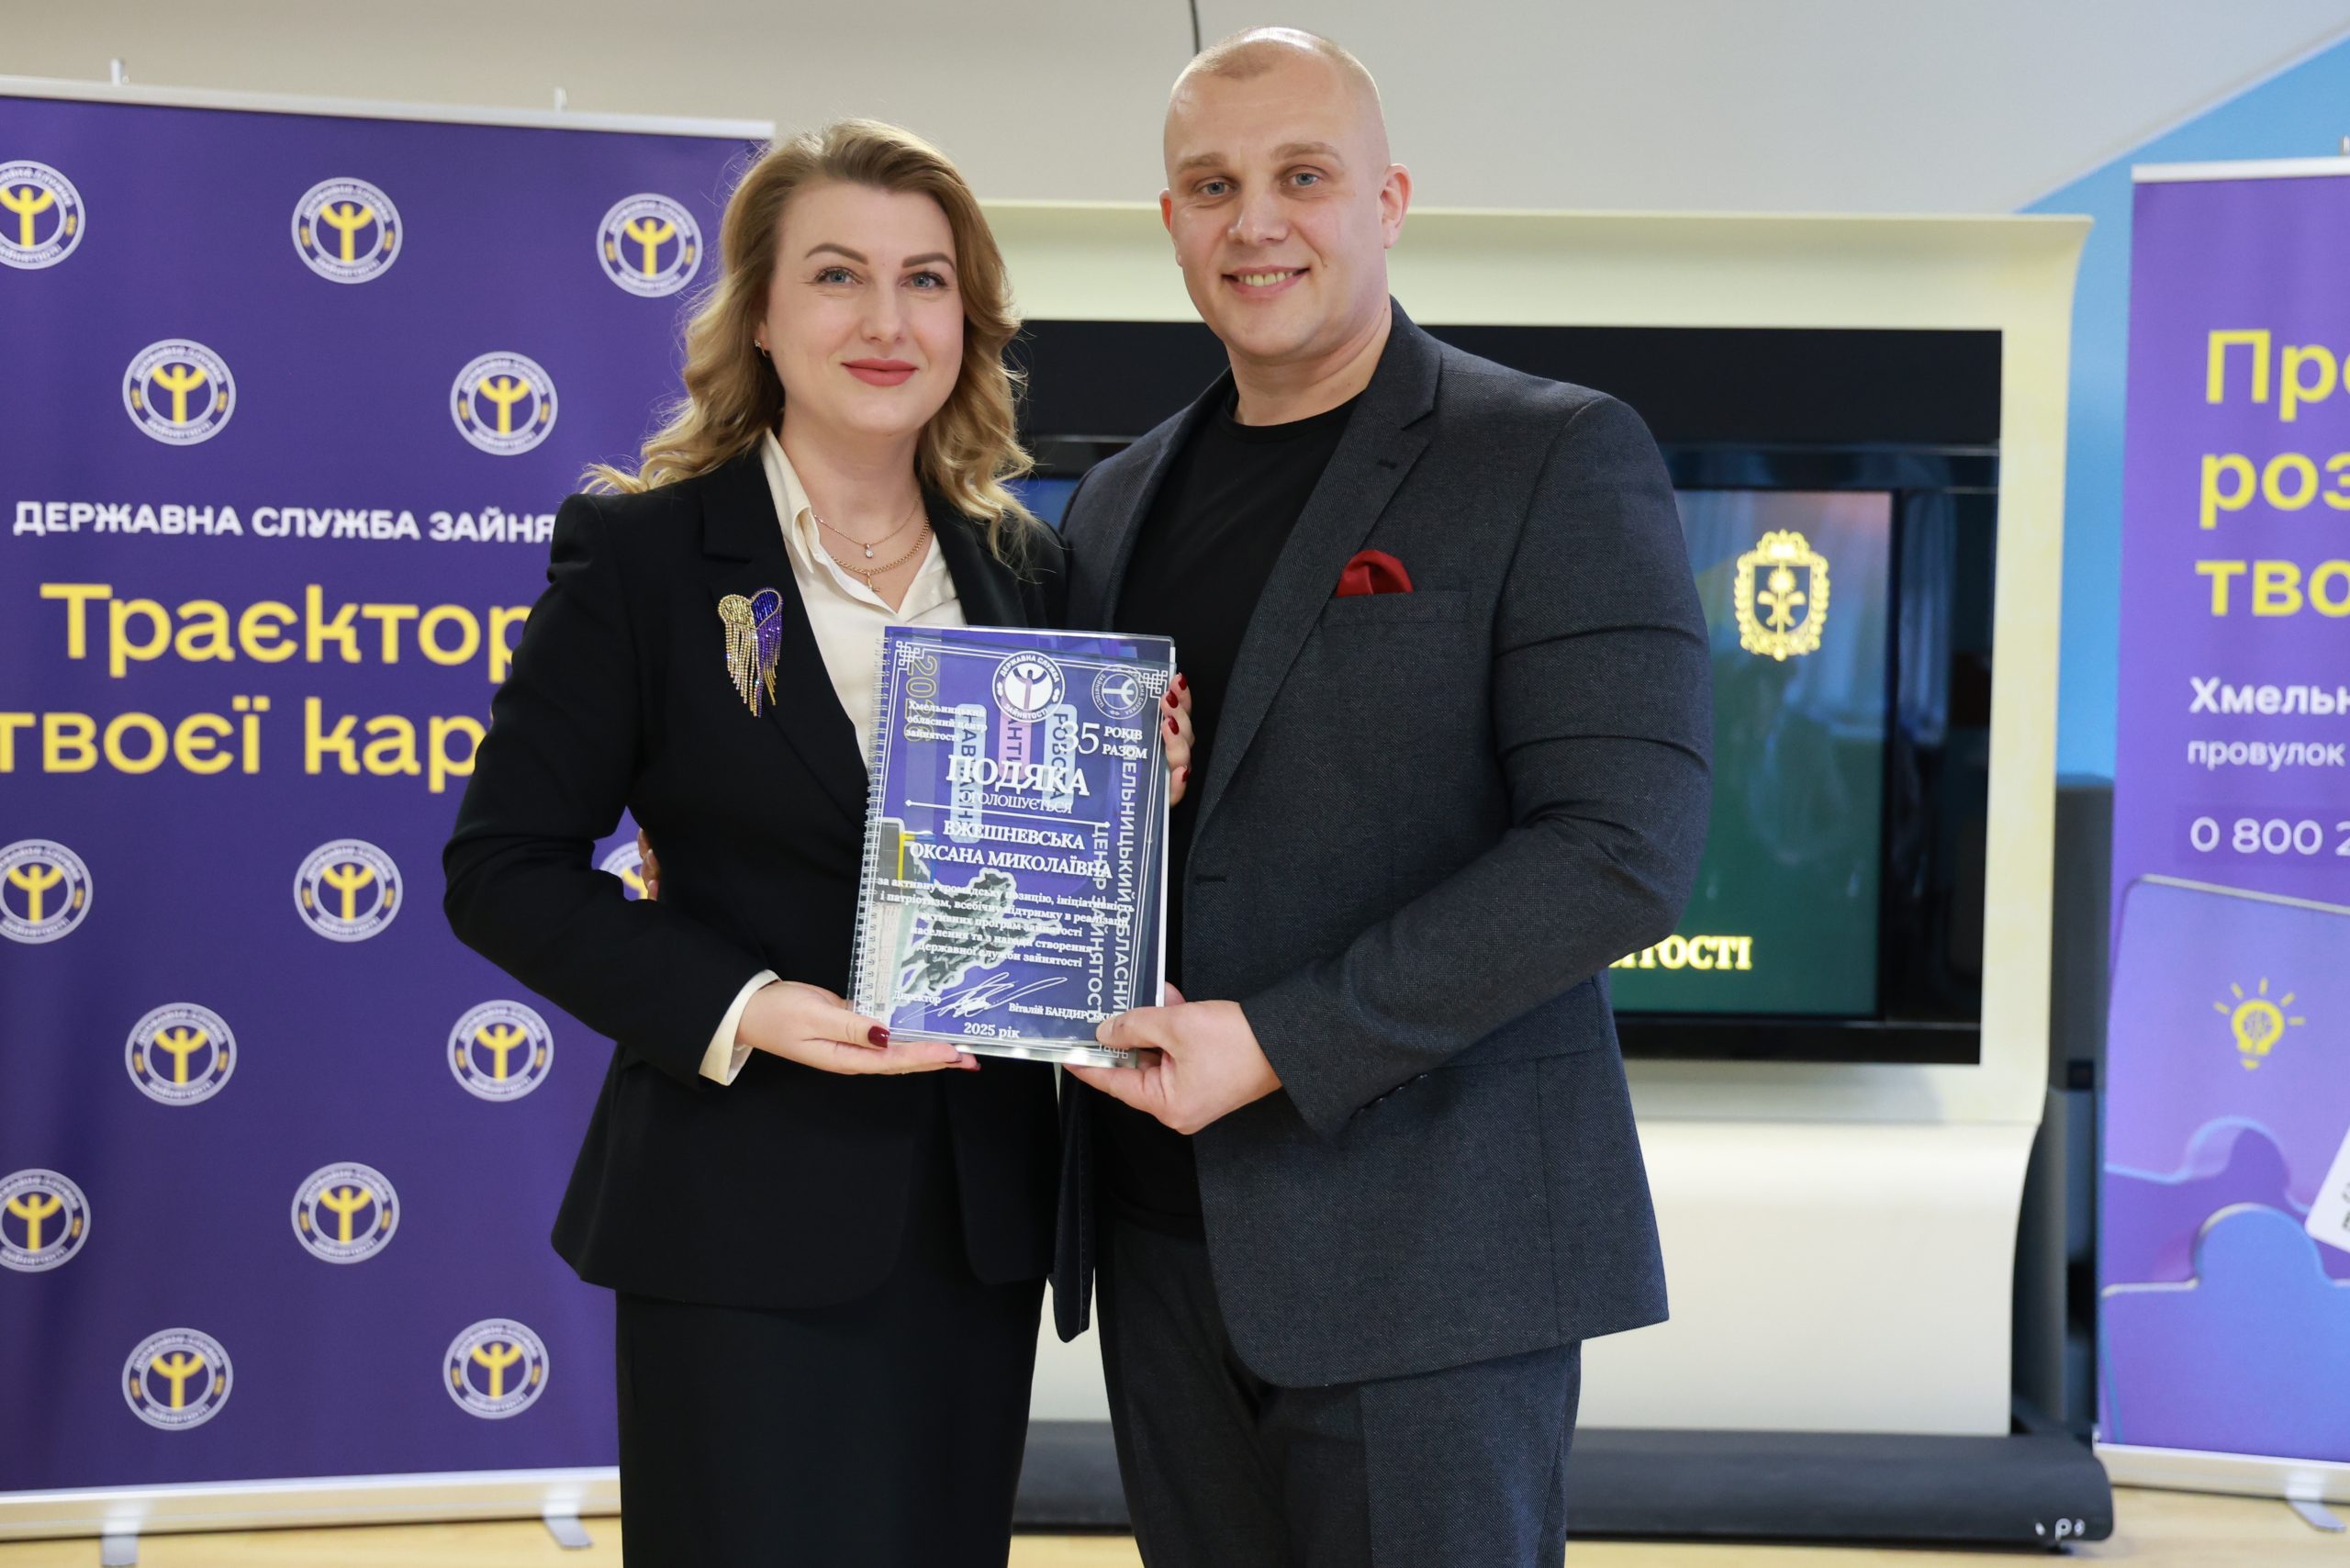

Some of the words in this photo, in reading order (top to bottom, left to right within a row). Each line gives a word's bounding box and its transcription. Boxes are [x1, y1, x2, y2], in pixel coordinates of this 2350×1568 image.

[2205, 328, 2350, 421] Пр
[13, 500, 243, 536] ДЕРЖАВНА
[252, 508, 420, 541] СЛУЖБА
[2195, 560, 2350, 617] тво
[39, 583, 534, 683] Траєктор
[999, 654, 1036, 678] ДЕРЖАВНА
[1036, 655, 1061, 683] СЛУЖБА
[1002, 702, 1048, 720] ЗАЙНЯТОСТІ
[0, 695, 271, 774] твоєї
[305, 696, 490, 793] кар
[1058, 720, 1101, 755] 35
[1103, 726, 1143, 740] РОКІВ
[1102, 744, 1147, 759] РАЗОМ
[2188, 739, 2346, 772] провулок
[946, 755, 1091, 796] ПОДЯКА
[961, 791, 1072, 814] ОГОЛОШУЄТЬСЯ
[943, 820, 1085, 850] ВЖЕШНЕВСЬКА
[2189, 816, 2221, 853] 0
[2232, 818, 2323, 855] 800
[910, 842, 984, 866] ОКСАНА
[988, 851, 1113, 879] МИКОЛАЇВНА
[878, 877, 890, 887] за
[891, 879, 936, 893] активну
[1005, 890, 1055, 904] позицію,
[887, 892, 952, 909] патріотизм,
[954, 901, 1002, 914] всебічну
[1064, 913, 1071, 921] в
[918, 913, 973, 926] активних
[974, 918, 1022, 932] програм
[910, 926, 969, 940] населення
[971, 933, 983, 942] та
[985, 935, 991, 943] з
[1035, 939, 1093, 954] створення
[916, 941, 978, 957] Державної
[1023, 952, 1083, 968] зайнятості
[1113, 907, 1132, 1016] ОБЛАСНИ
[892, 990, 942, 1005] Директор
[1008, 1002, 1045, 1015] Віталій
[1045, 1006, 1113, 1022] БАНДИРСЬК
[964, 1021, 995, 1036] 2025
[998, 1025, 1021, 1039] рік
